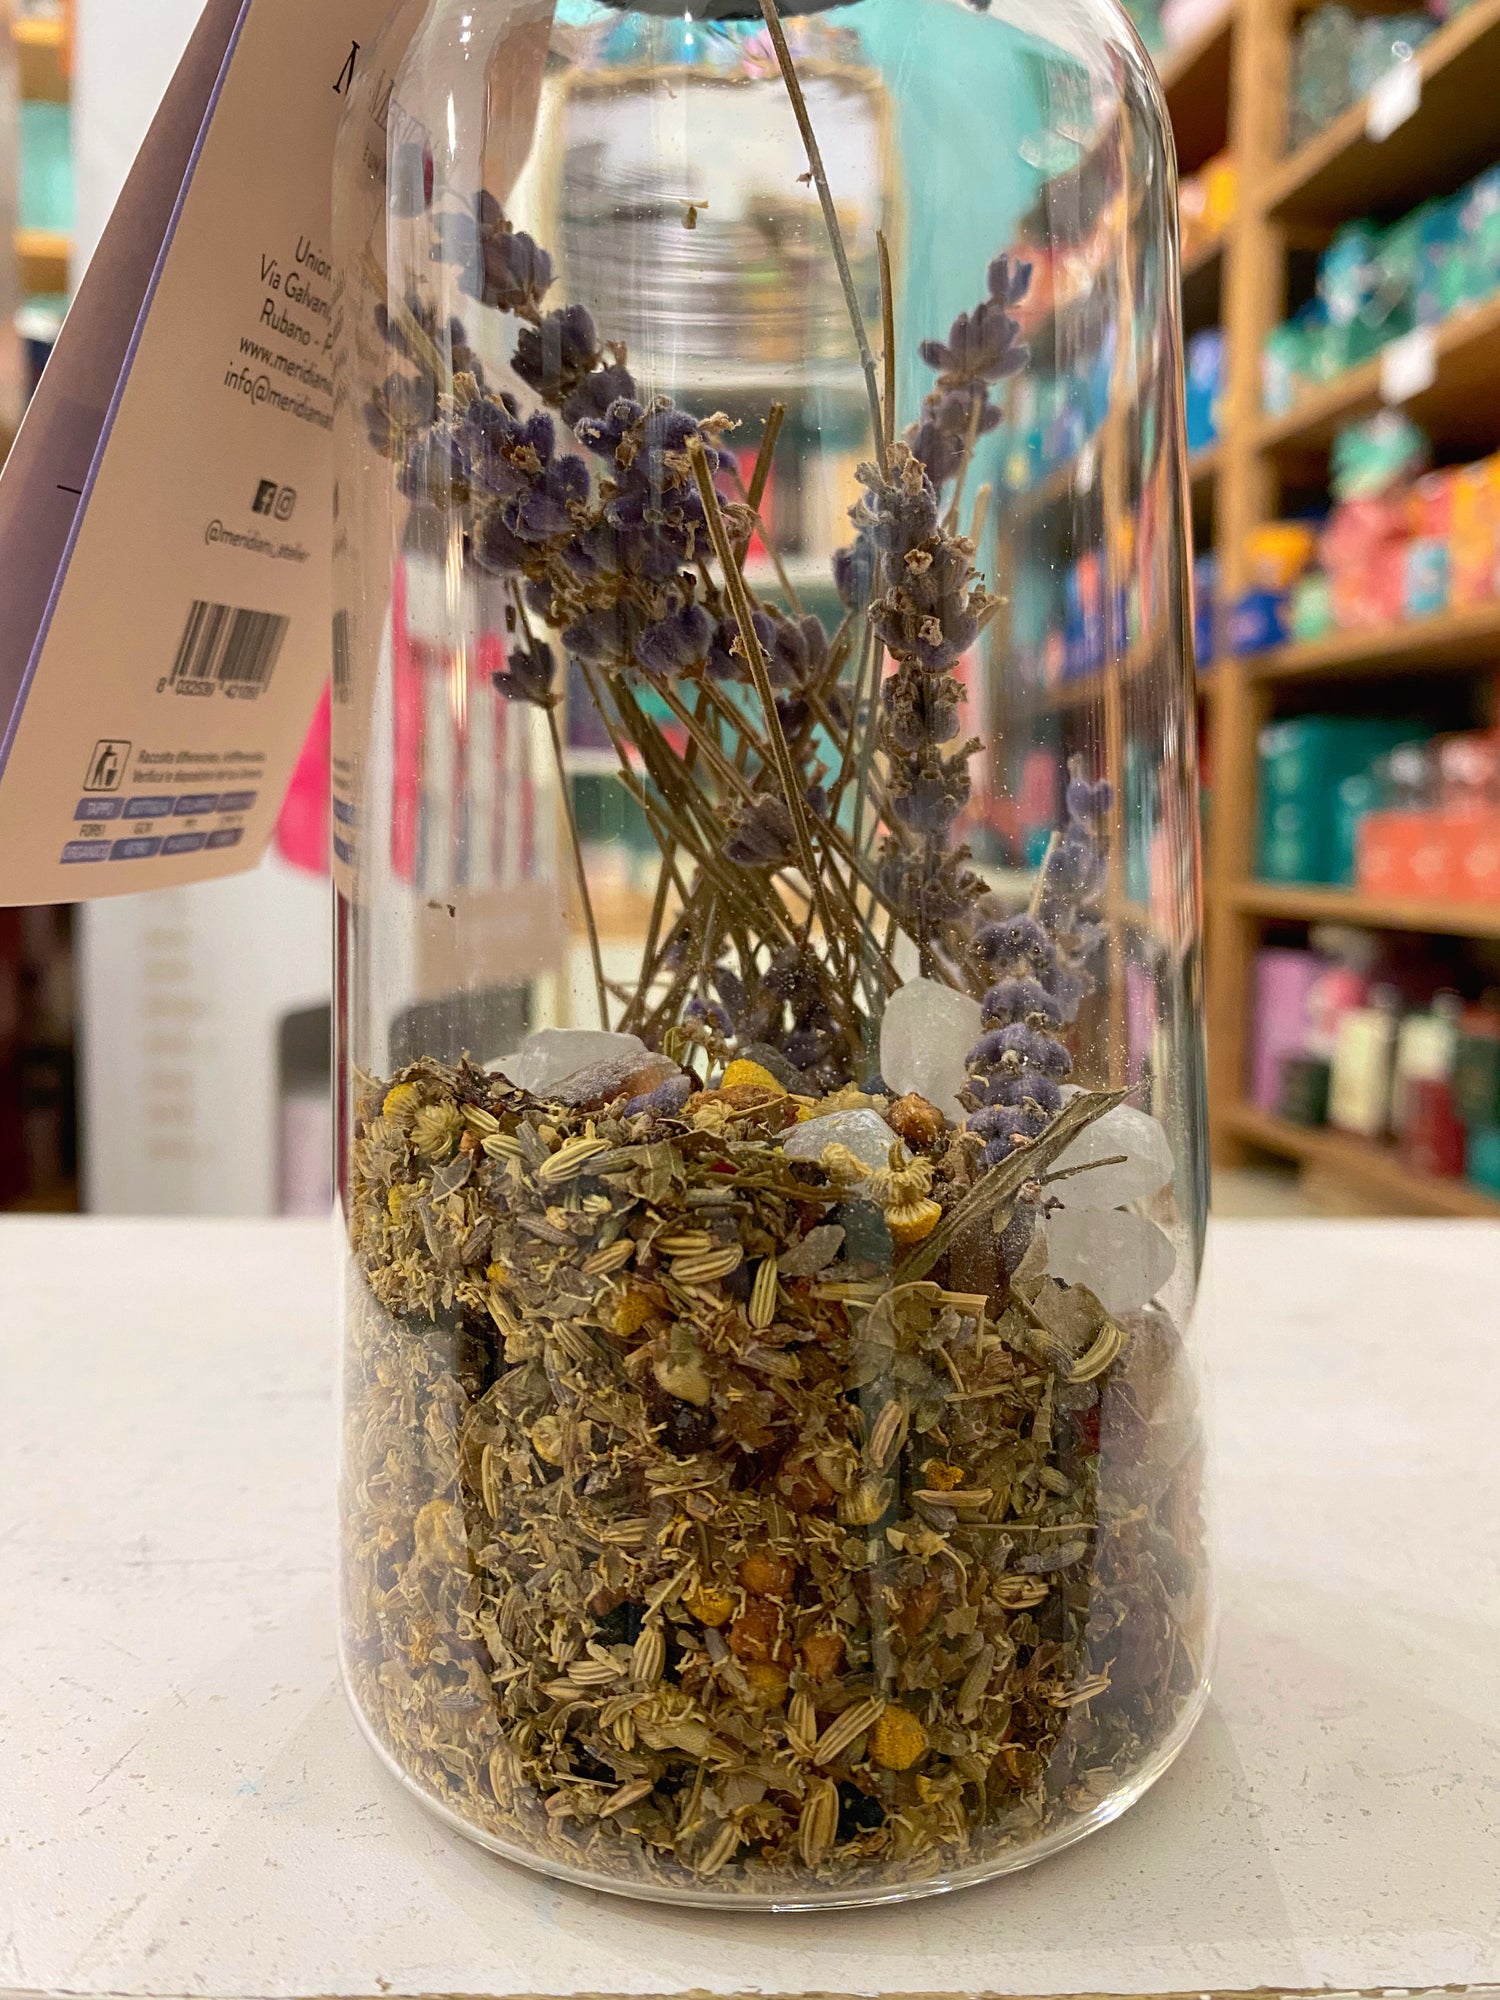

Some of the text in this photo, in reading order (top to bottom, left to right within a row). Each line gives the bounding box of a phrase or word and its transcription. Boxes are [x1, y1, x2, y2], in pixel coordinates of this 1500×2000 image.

[259, 253, 281, 290] Via
[259, 298, 311, 346] Rubano
[156, 677, 167, 693] 8
